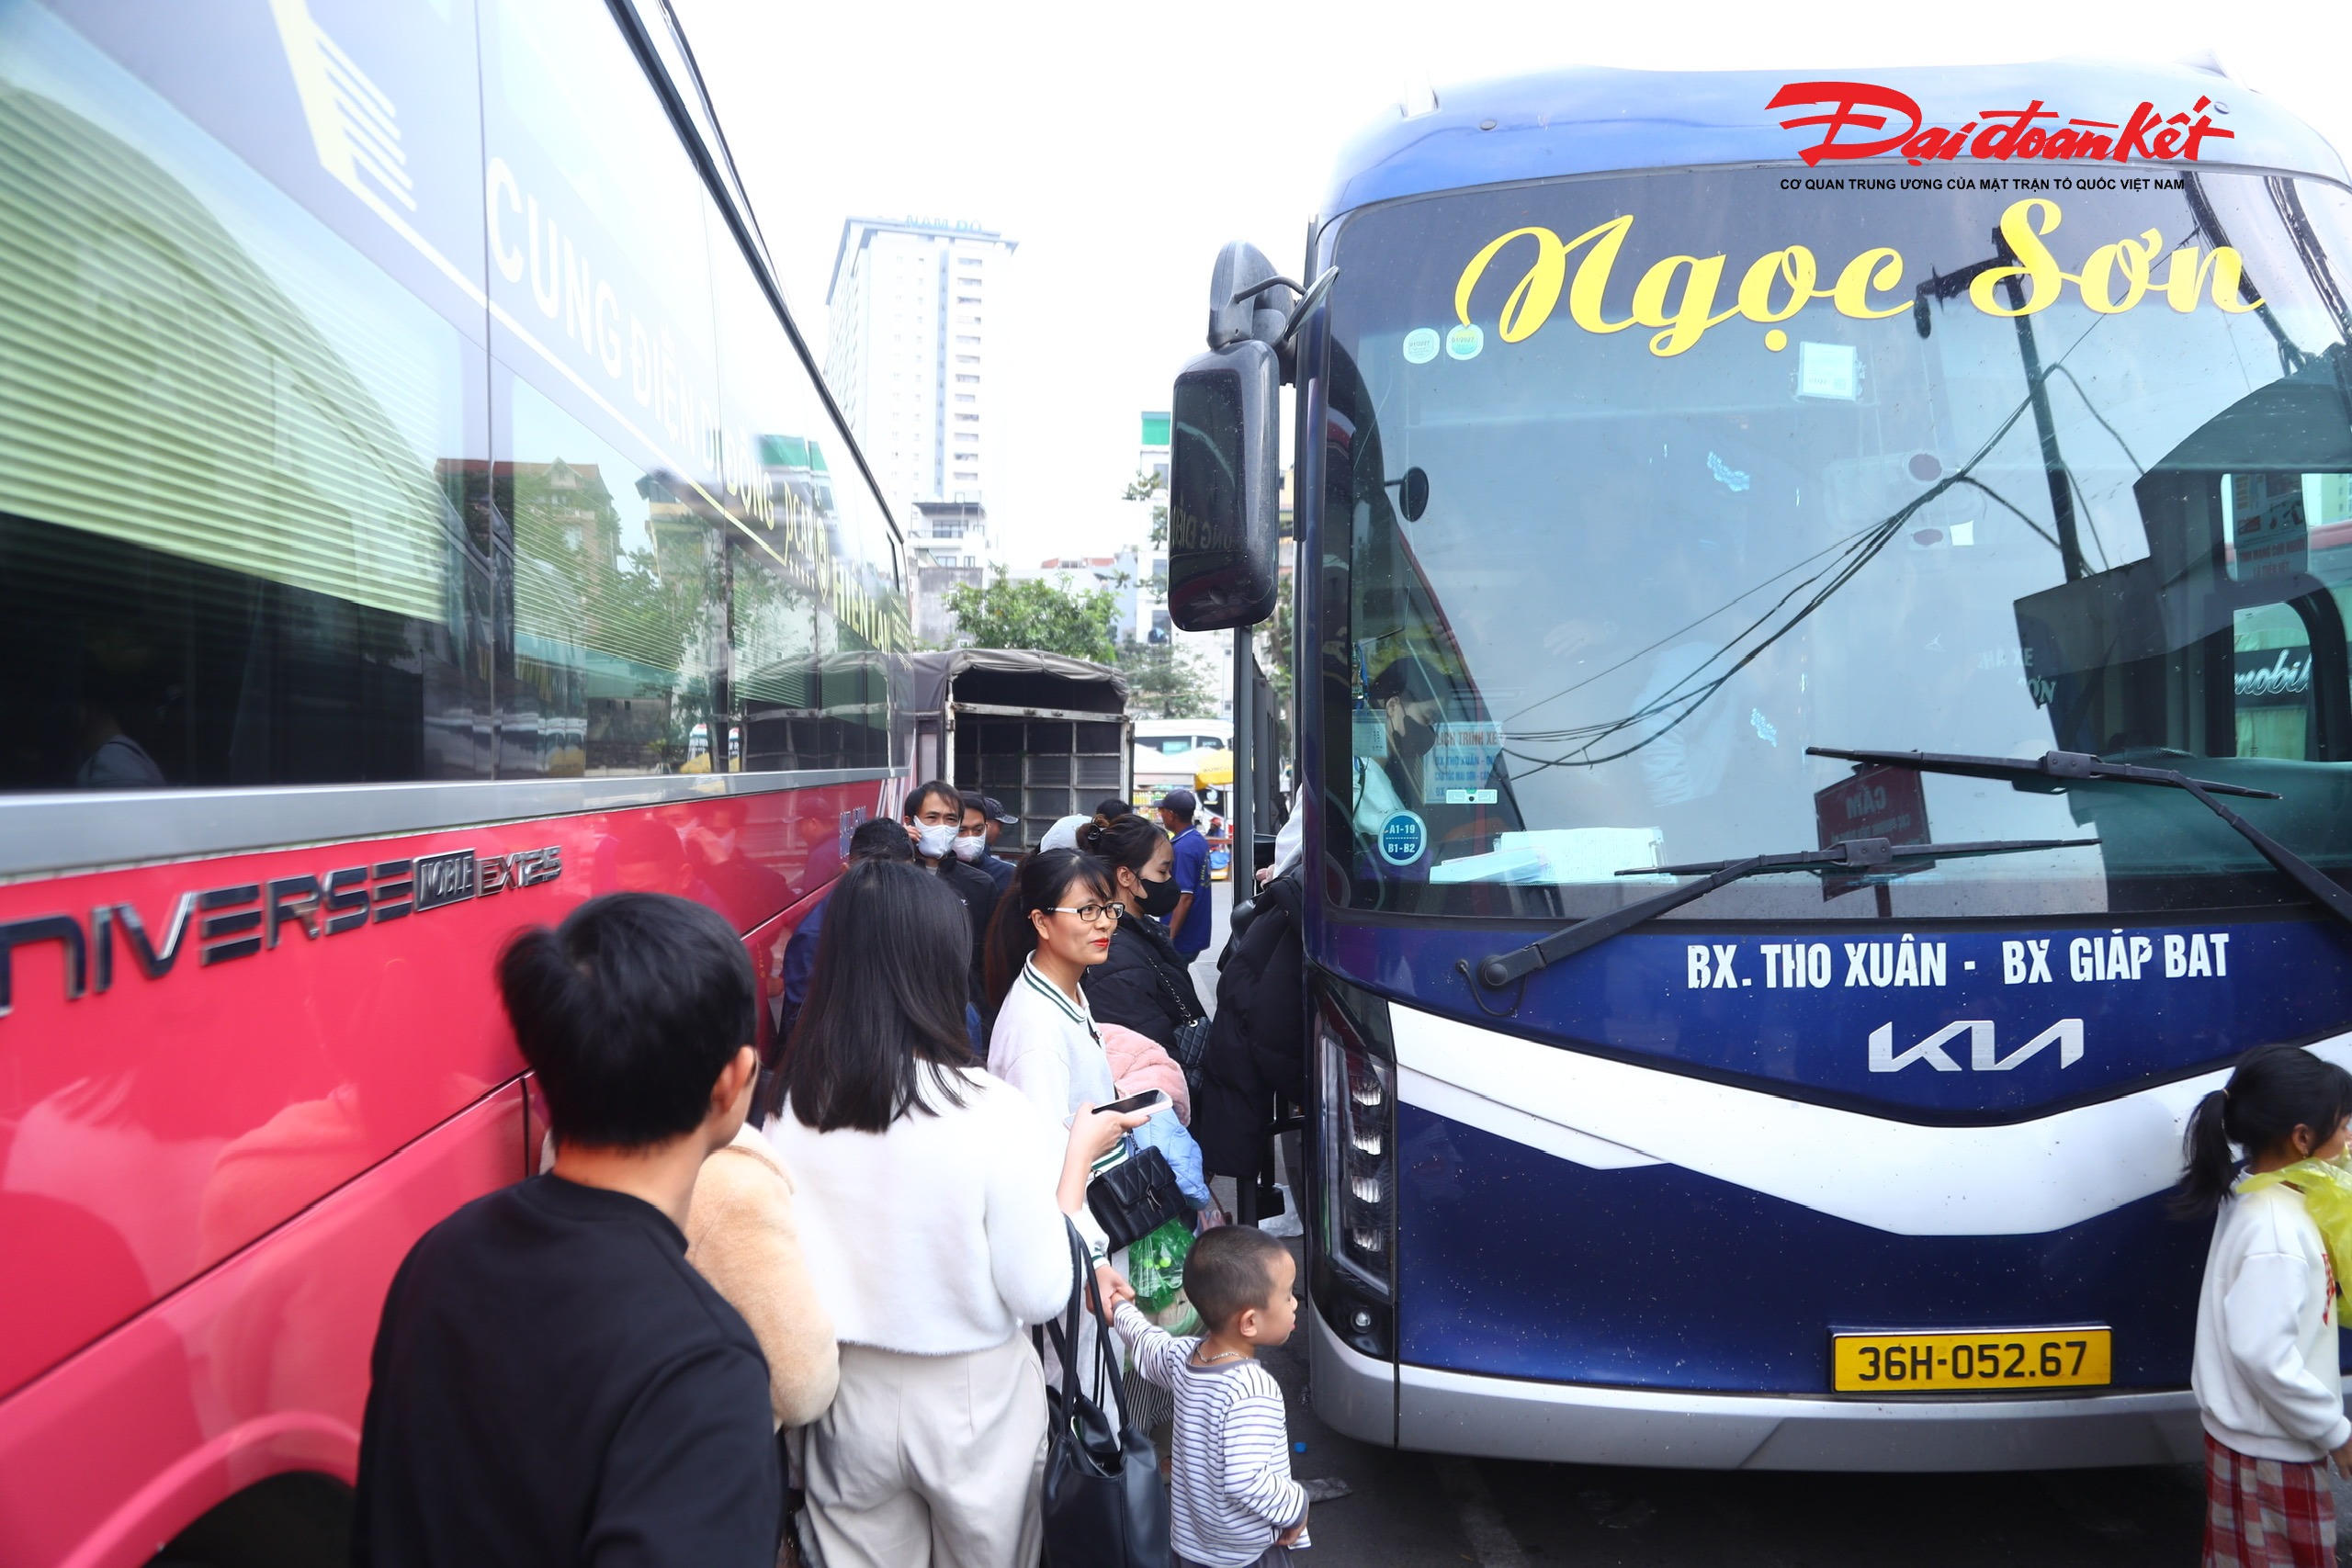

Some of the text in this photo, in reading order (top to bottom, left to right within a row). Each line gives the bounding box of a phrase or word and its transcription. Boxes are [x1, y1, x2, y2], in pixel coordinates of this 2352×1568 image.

[486, 156, 623, 379] CUNG
[1454, 197, 2267, 358] Ngọc Sơn
[1388, 843, 1416, 853] B1-B2
[1389, 824, 1416, 834] A1-19
[1687, 944, 1752, 989] BX.
[1843, 933, 1947, 987] XUÂN
[2002, 939, 2053, 985] BX
[2069, 928, 2154, 982] GIÁP
[1858, 1340, 2087, 1382] 36H-052.67
